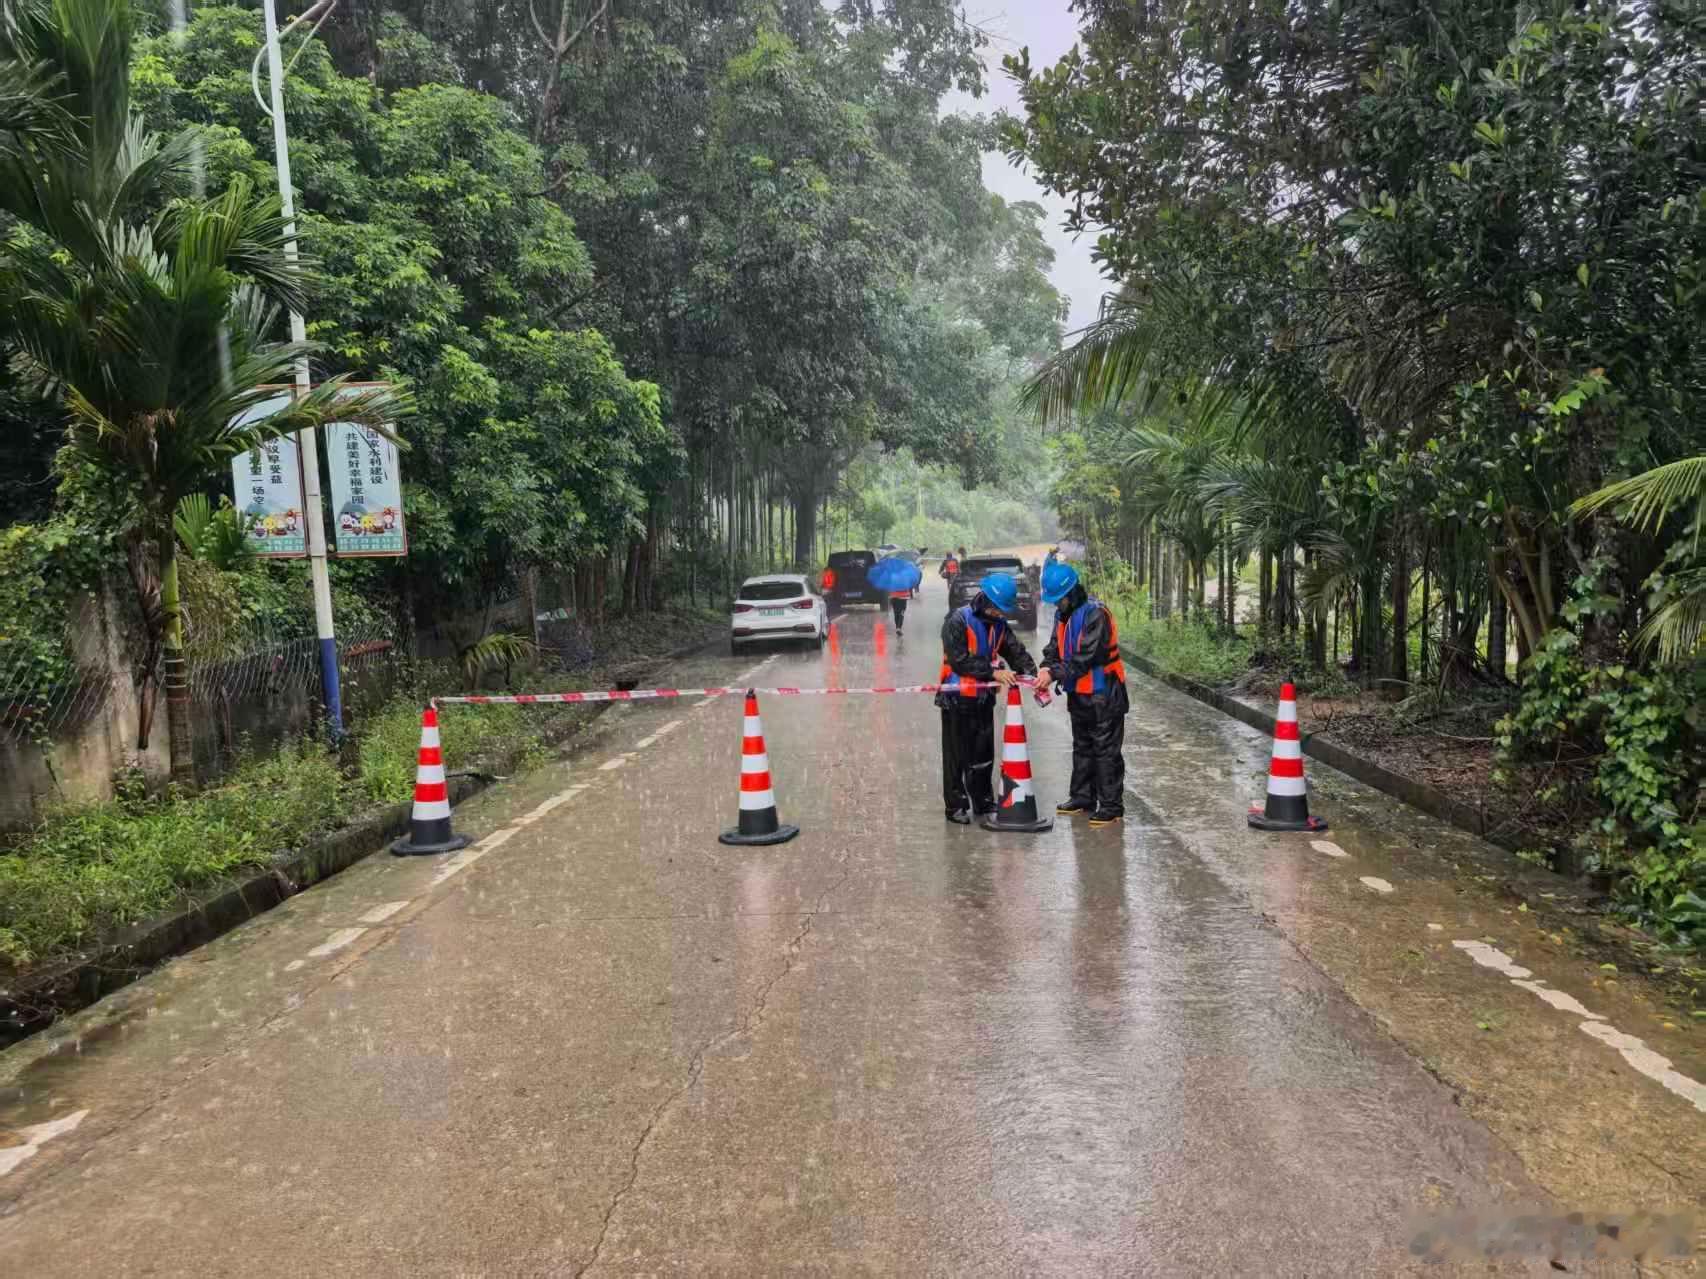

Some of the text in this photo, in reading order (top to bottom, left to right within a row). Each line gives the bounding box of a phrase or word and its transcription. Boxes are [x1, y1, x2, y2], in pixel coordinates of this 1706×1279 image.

[345, 432, 365, 505] 共建美好幸福家园
